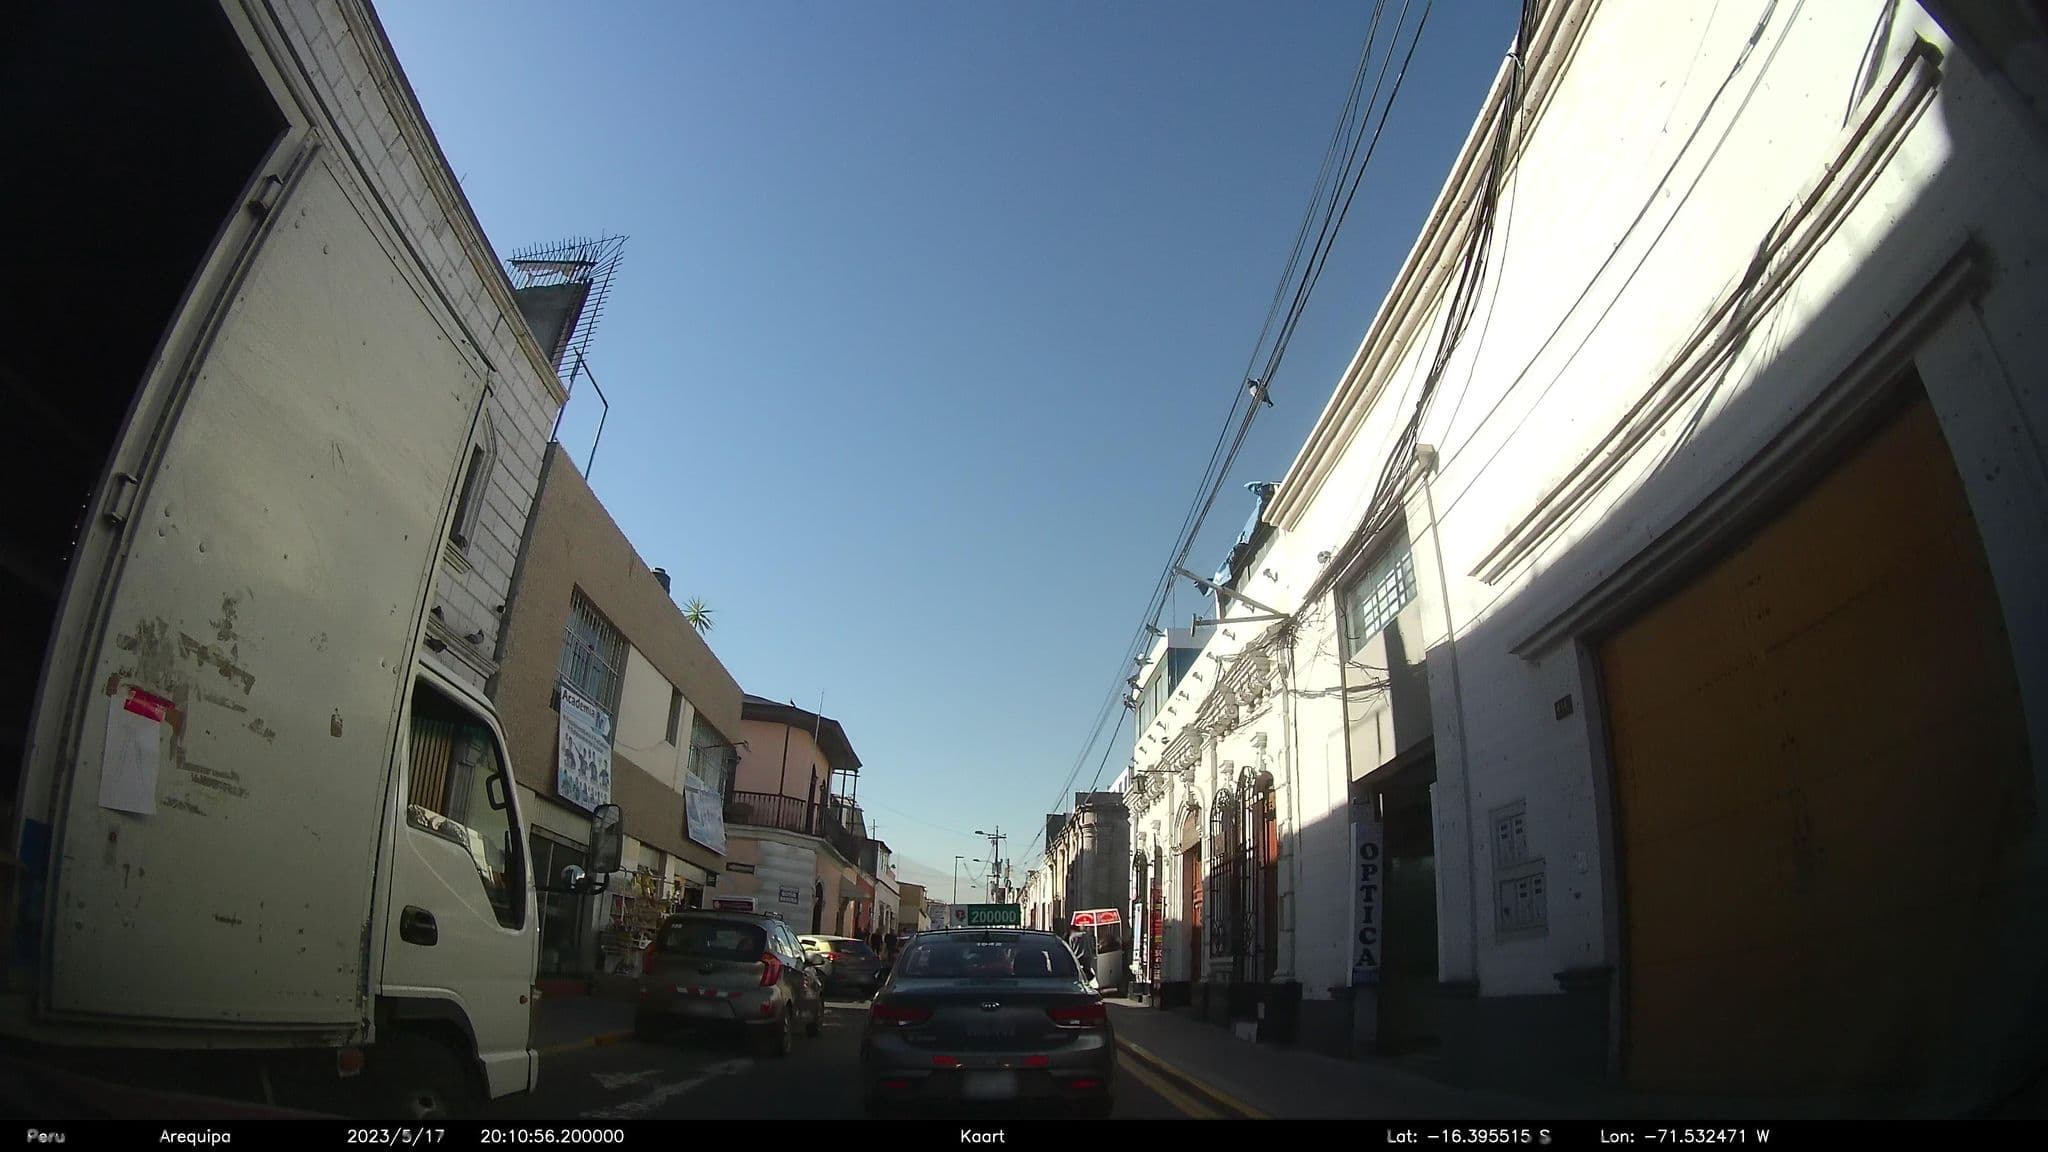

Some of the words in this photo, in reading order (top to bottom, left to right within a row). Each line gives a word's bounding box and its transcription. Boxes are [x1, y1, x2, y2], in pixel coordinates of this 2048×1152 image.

[562, 690, 596, 718] Academia
[972, 910, 1017, 923] 200000
[1356, 842, 1379, 967] OPTICA
